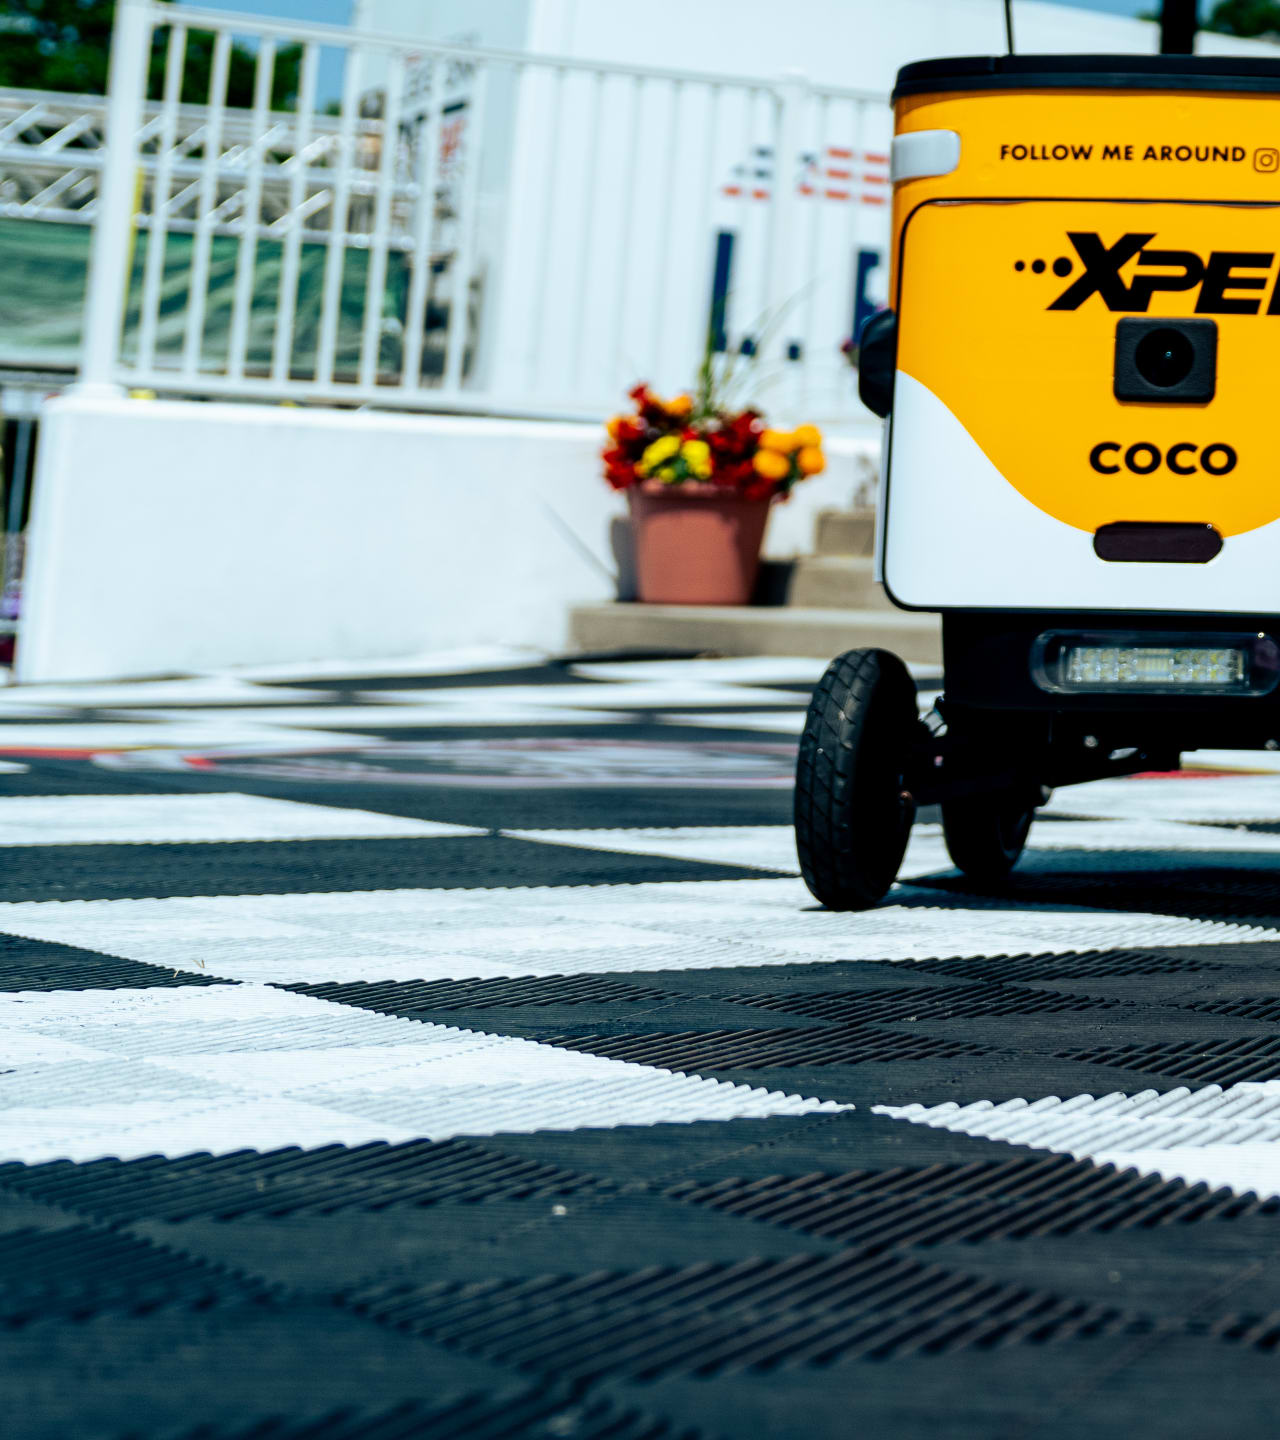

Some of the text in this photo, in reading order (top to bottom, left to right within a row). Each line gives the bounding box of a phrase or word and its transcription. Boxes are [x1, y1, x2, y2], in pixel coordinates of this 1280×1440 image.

[1000, 144, 1094, 162] FOLLOW
[1101, 145, 1134, 162] ME
[1142, 145, 1247, 163] AROUND
[1089, 441, 1238, 476] COCO
